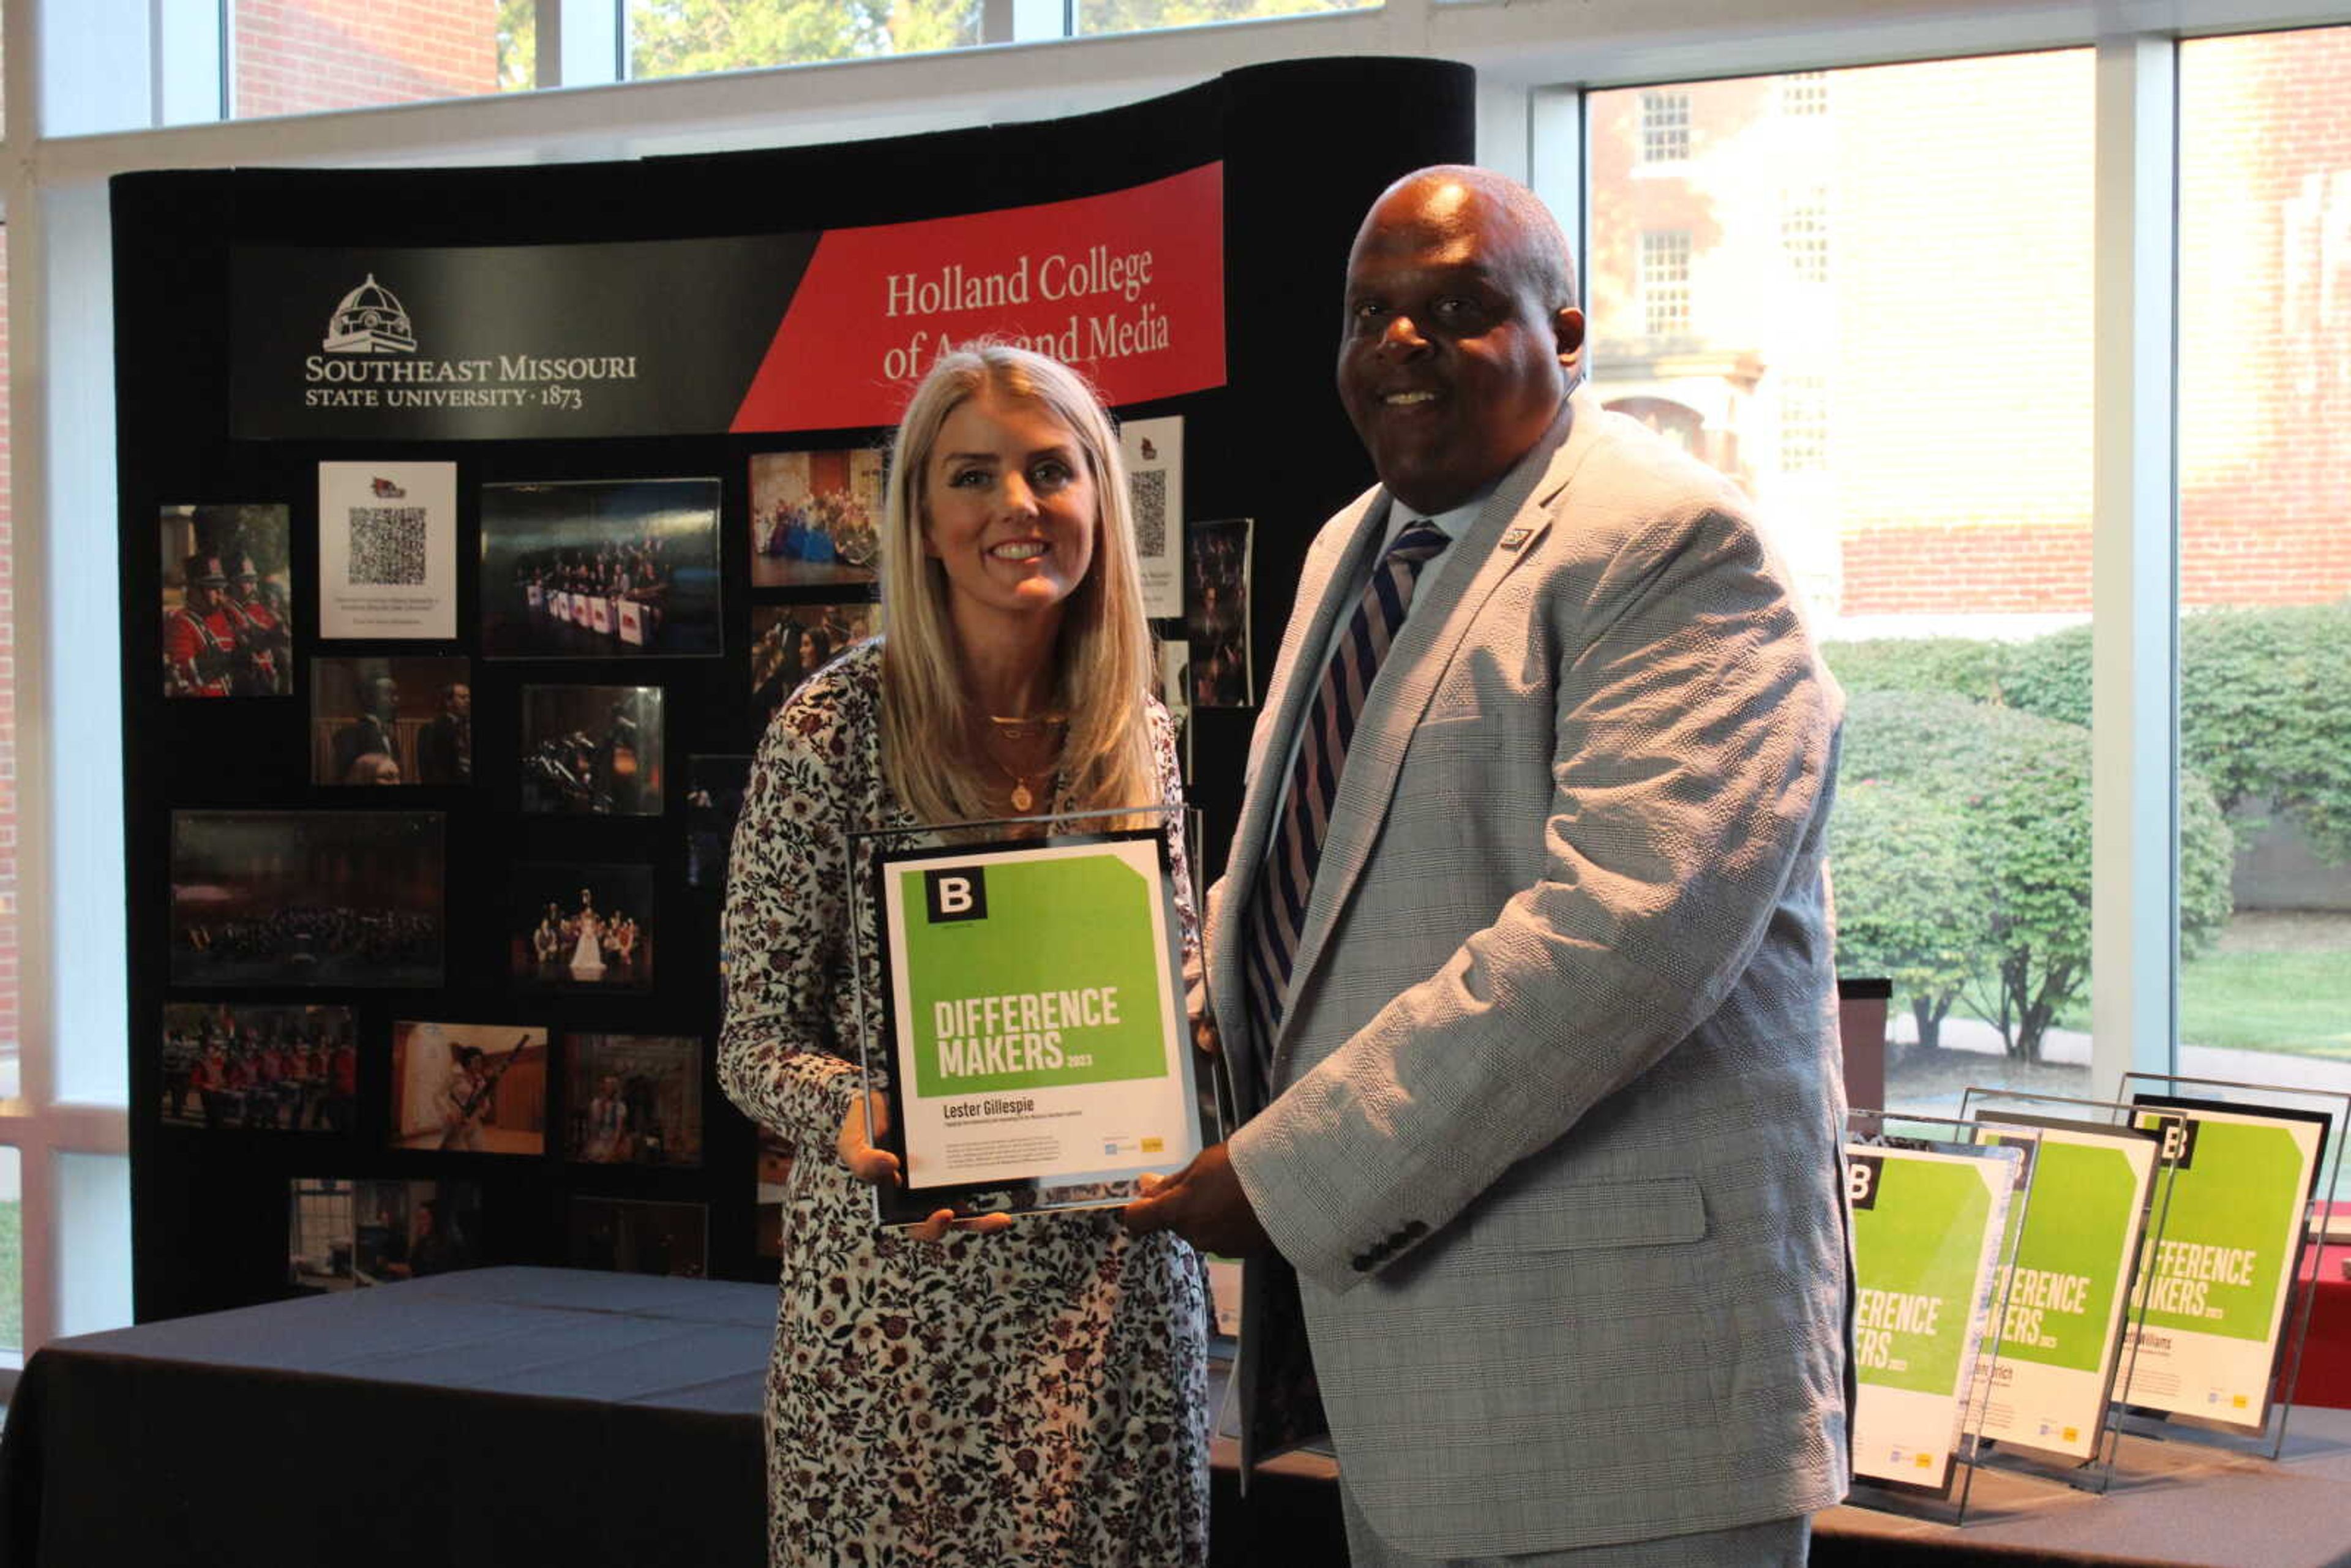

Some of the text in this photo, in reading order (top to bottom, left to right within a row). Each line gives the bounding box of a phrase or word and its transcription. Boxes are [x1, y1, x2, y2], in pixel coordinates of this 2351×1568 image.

[885, 245, 1153, 317] Holland College
[883, 331, 928, 380] of
[1088, 303, 1170, 361] Media
[306, 355, 637, 383] SOUTHEAST MISSOURI
[306, 384, 583, 410] STATE UNIVERSITY 1873
[939, 877, 973, 913] B
[934, 987, 1120, 1039] DIFFERENCE
[938, 1032, 1065, 1079] MAKERS
[943, 1103, 981, 1119] Lester
[983, 1097, 1035, 1117] Gillespie
[2161, 1126, 2188, 1159] B
